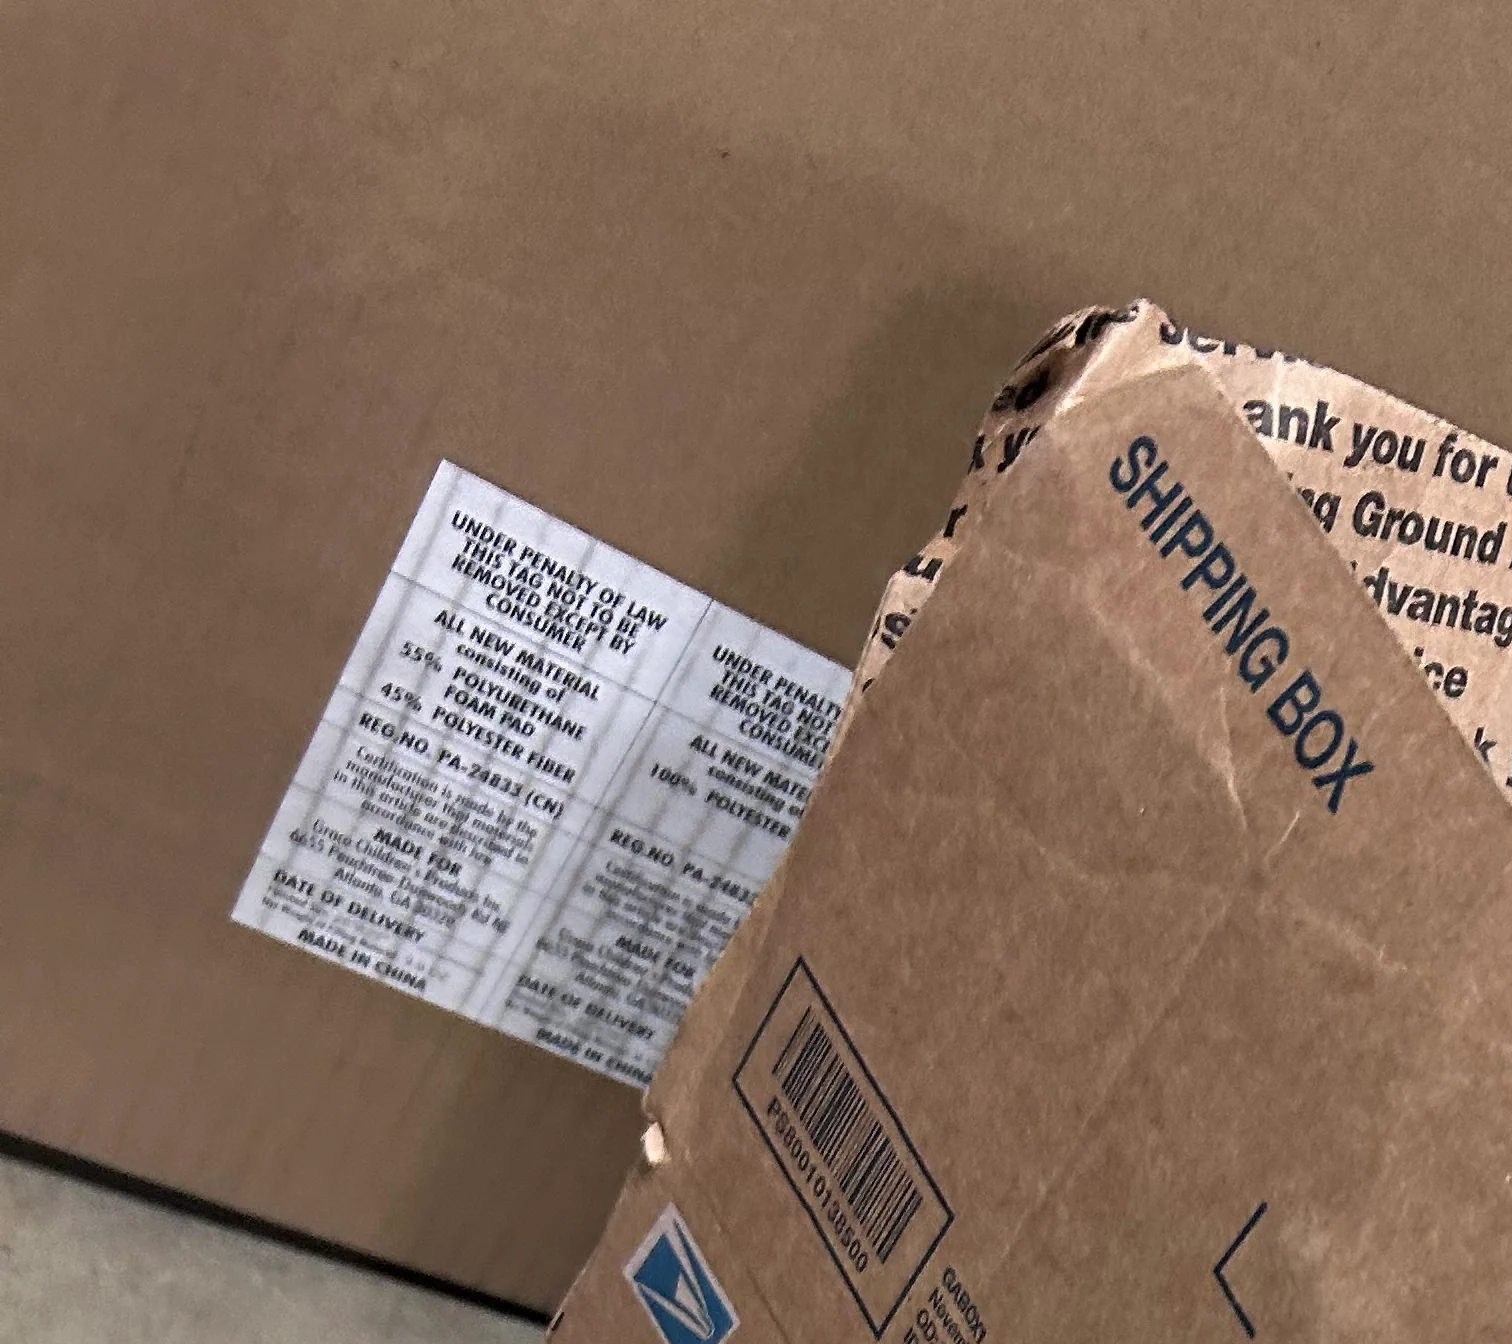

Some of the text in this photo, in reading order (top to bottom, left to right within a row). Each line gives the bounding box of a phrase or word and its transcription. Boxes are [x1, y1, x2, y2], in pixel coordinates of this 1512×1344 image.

[1242, 399, 1341, 454] ank
[1342, 422, 1426, 473] you
[1431, 433, 1500, 489] for
[1351, 490, 1508, 566] Ground
[451, 511, 668, 631] UNDER PENALTY OF LAW
[451, 553, 636, 655] REMOVED EXCEPT BY
[462, 537, 638, 639] THIS TAG NOT TO BE
[433, 609, 600, 701] ALL NEW MATERIAL
[485, 593, 587, 654] CONSUMER
[1109, 435, 1248, 623] SHIPPING
[1265, 654, 1375, 816] BOX
[399, 641, 584, 740] 55% POLYURETHANE
[456, 644, 566, 703] consisting of
[712, 645, 773, 686] UNDER
[380, 682, 576, 784] 45% POLYESTER FIBER
[443, 684, 535, 737] FOAM PAD
[710, 684, 792, 734] REMOVED
[722, 669, 833, 736] THIS TAG NOT
[436, 749, 524, 798] PA-24833
[524, 789, 565, 821] (CN)
[688, 734, 718, 758] ALL
[721, 749, 762, 778] NEW
[707, 765, 786, 814] consisting
[650, 763, 791, 838] 100% POLYESTER
[372, 827, 462, 876] MADE FOR
[273, 869, 425, 942] DATE OF DELIVERY
[297, 929, 426, 992] MADE IN CHINA
